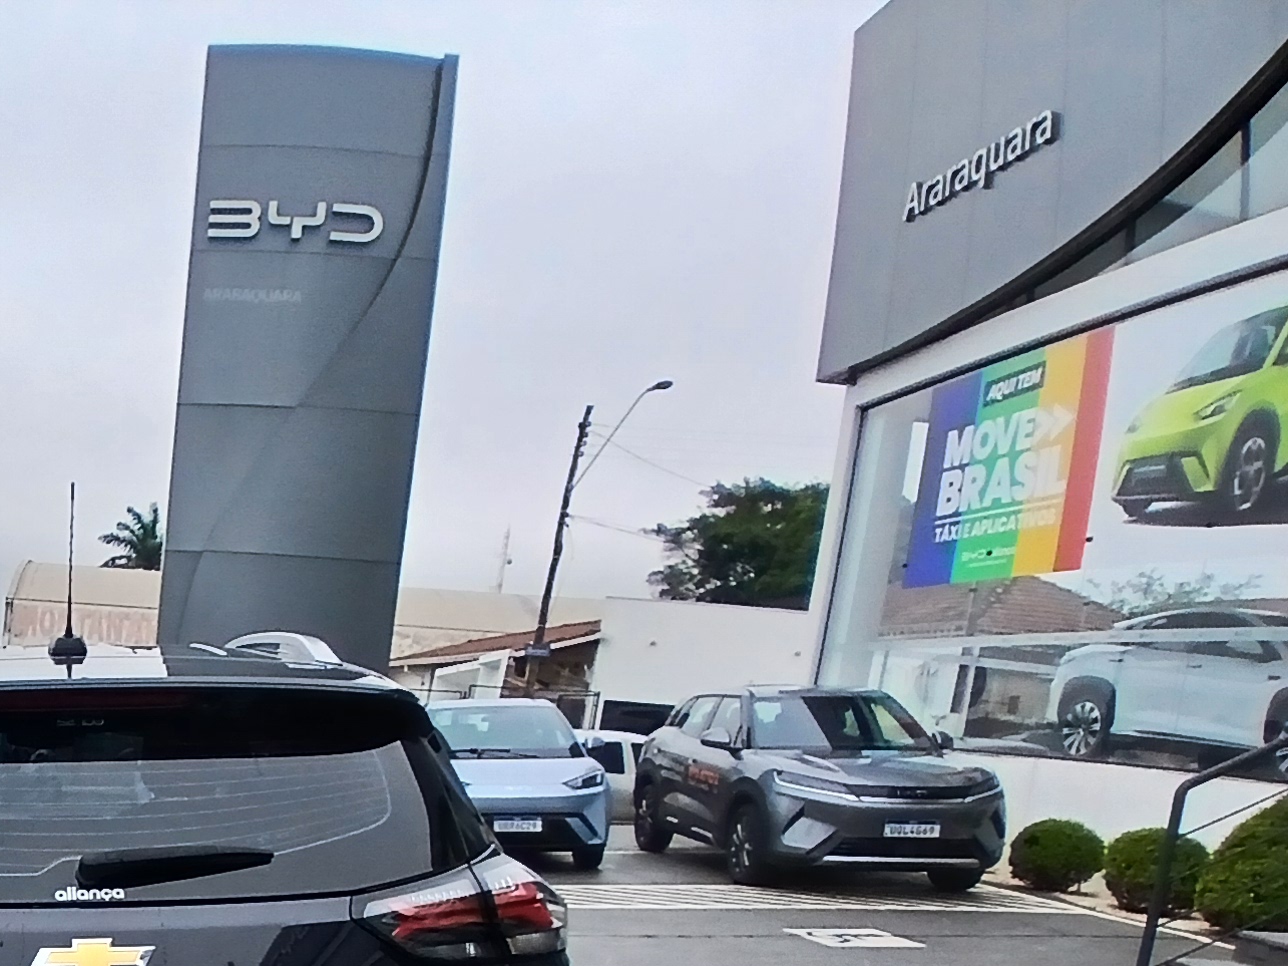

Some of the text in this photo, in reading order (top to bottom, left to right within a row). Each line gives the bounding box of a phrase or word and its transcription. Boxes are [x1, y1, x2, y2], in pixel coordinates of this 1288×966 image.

[902, 109, 1053, 221] Araraquara
[207, 200, 384, 243] BYD
[986, 366, 1043, 400] AQUI TEM
[943, 407, 1040, 469] MOVE
[935, 445, 1066, 517] BRASIL
